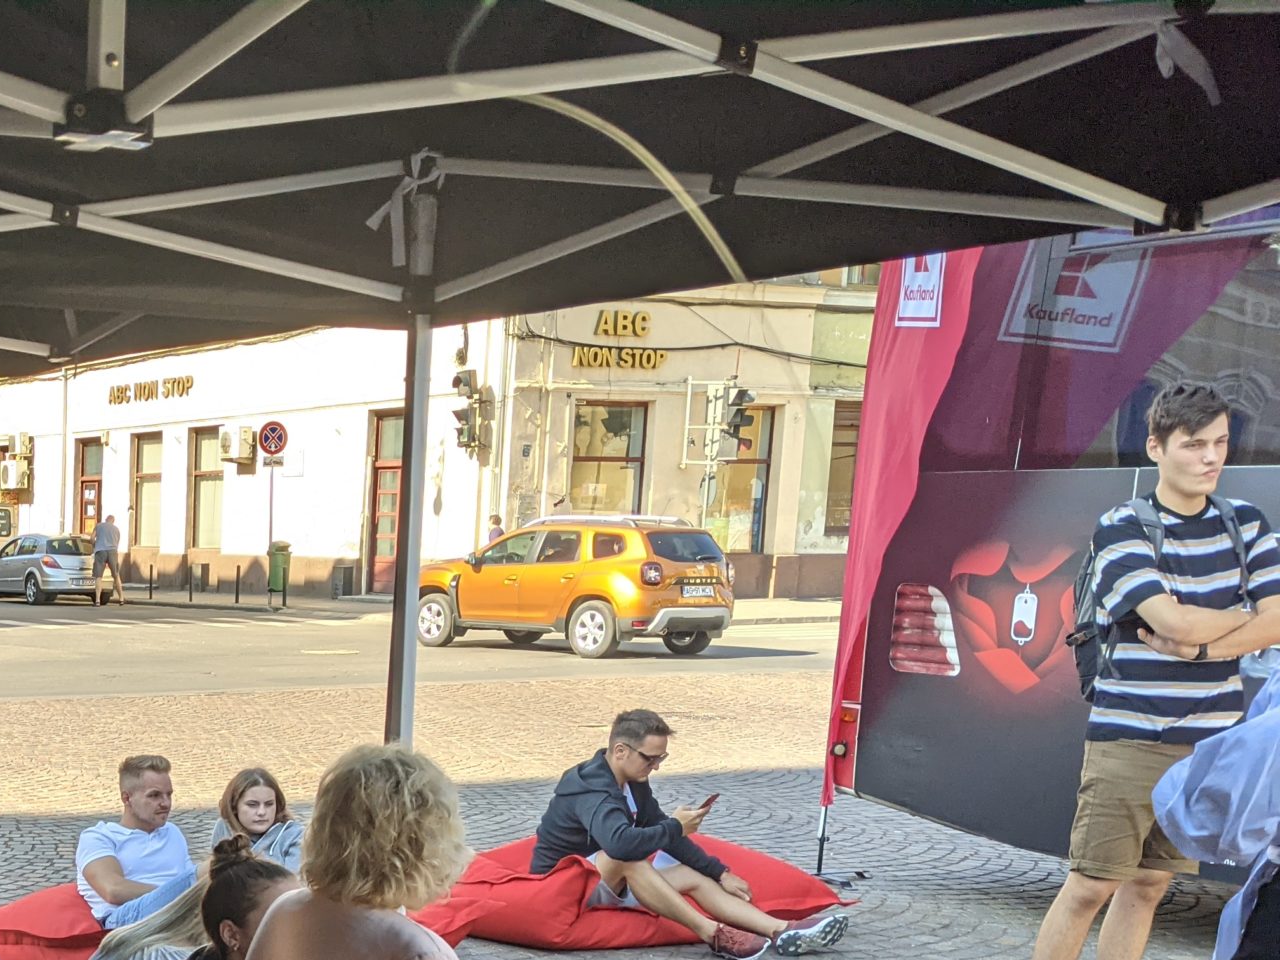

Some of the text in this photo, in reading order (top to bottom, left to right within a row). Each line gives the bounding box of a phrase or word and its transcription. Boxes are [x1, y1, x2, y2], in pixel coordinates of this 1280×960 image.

[904, 284, 935, 302] Kaufland
[594, 310, 652, 337] ABC
[1024, 303, 1114, 329] Kaufland
[572, 346, 668, 370] NON STOP
[108, 375, 194, 406] ABC NON STOP
